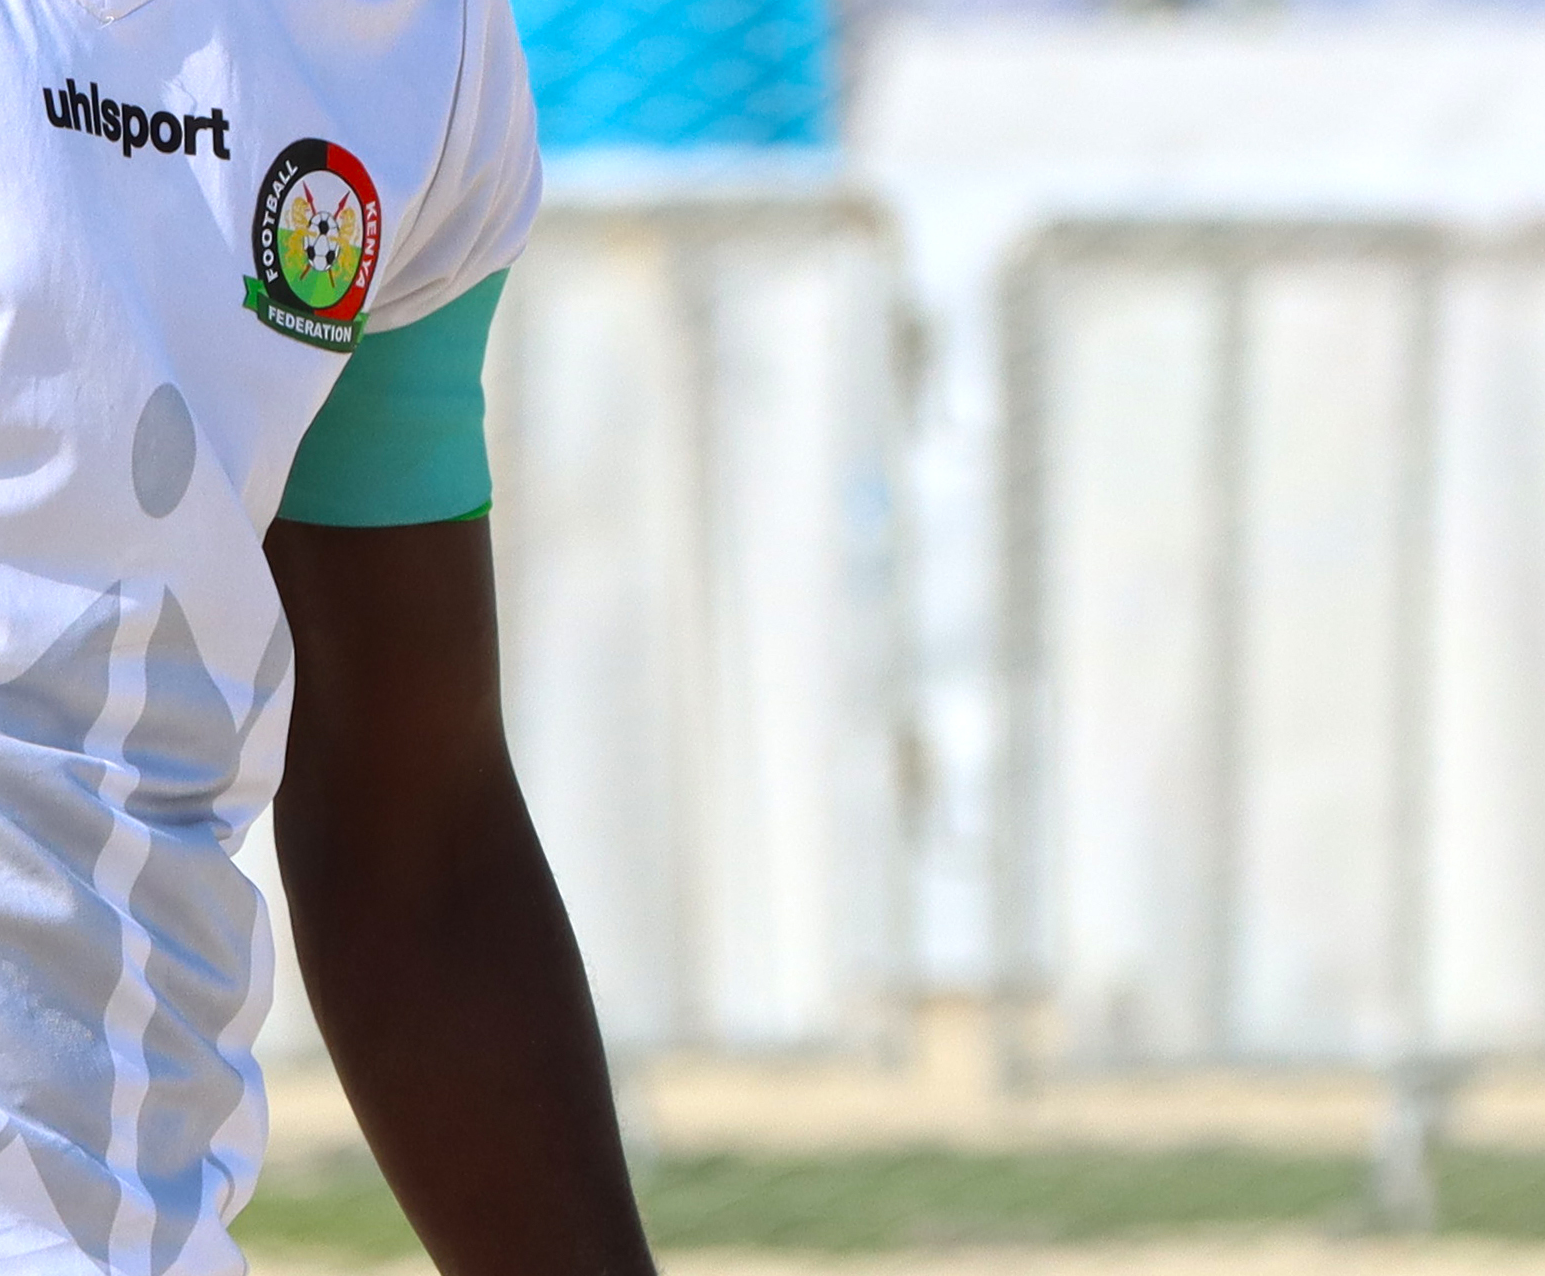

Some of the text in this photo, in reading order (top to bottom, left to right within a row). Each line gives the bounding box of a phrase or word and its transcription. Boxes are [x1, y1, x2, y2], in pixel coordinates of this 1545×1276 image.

[42, 77, 231, 161] uhlsport
[261, 159, 299, 284] FOOTBALL
[355, 200, 378, 289] KENYA
[267, 304, 354, 343] FEDERATION
